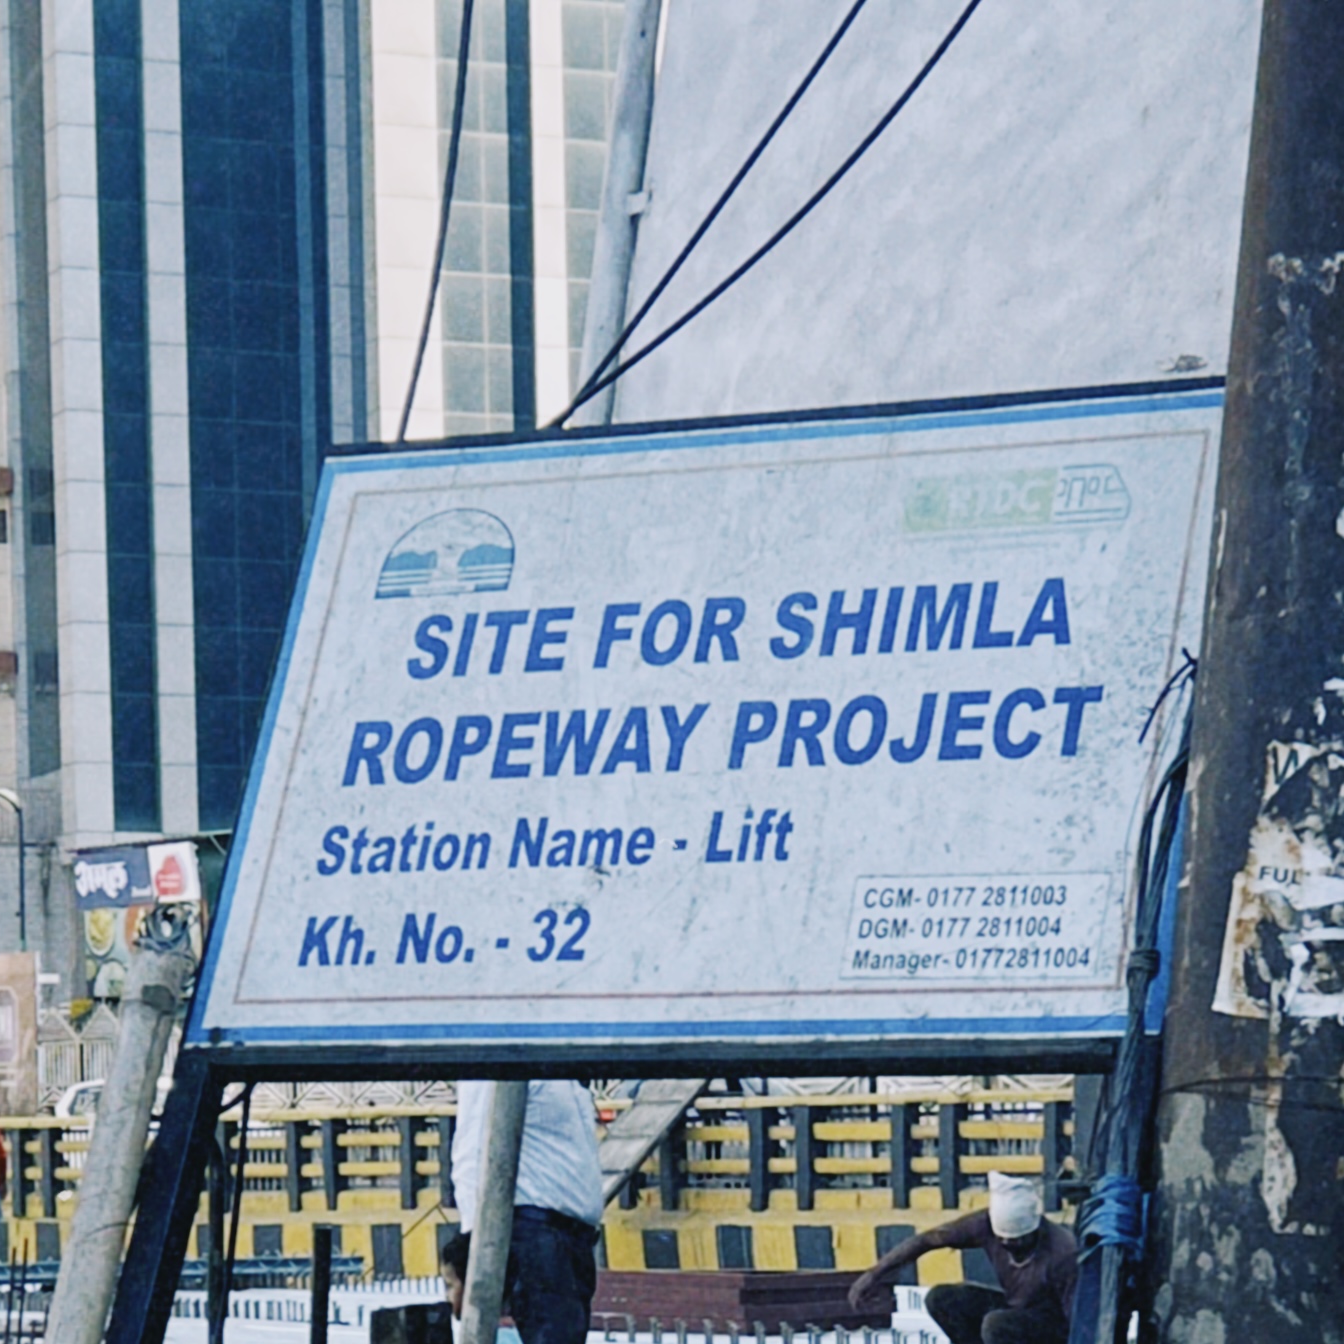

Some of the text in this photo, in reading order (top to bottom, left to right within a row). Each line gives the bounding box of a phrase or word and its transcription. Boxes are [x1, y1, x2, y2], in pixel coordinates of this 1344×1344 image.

[406, 577, 1072, 680] SITE FOR SHIMLA
[340, 685, 1105, 788] ROPEWAY PROJECT
[316, 821, 492, 876] Station
[508, 817, 655, 869] Name
[705, 808, 794, 863] Lift
[863, 884, 1067, 909] CGM- 0177 2811003
[298, 907, 591, 967] Kh. No. - 32
[858, 916, 1062, 939] DGM- 0177 2811004
[852, 947, 1091, 975] Manager- 01772811004
